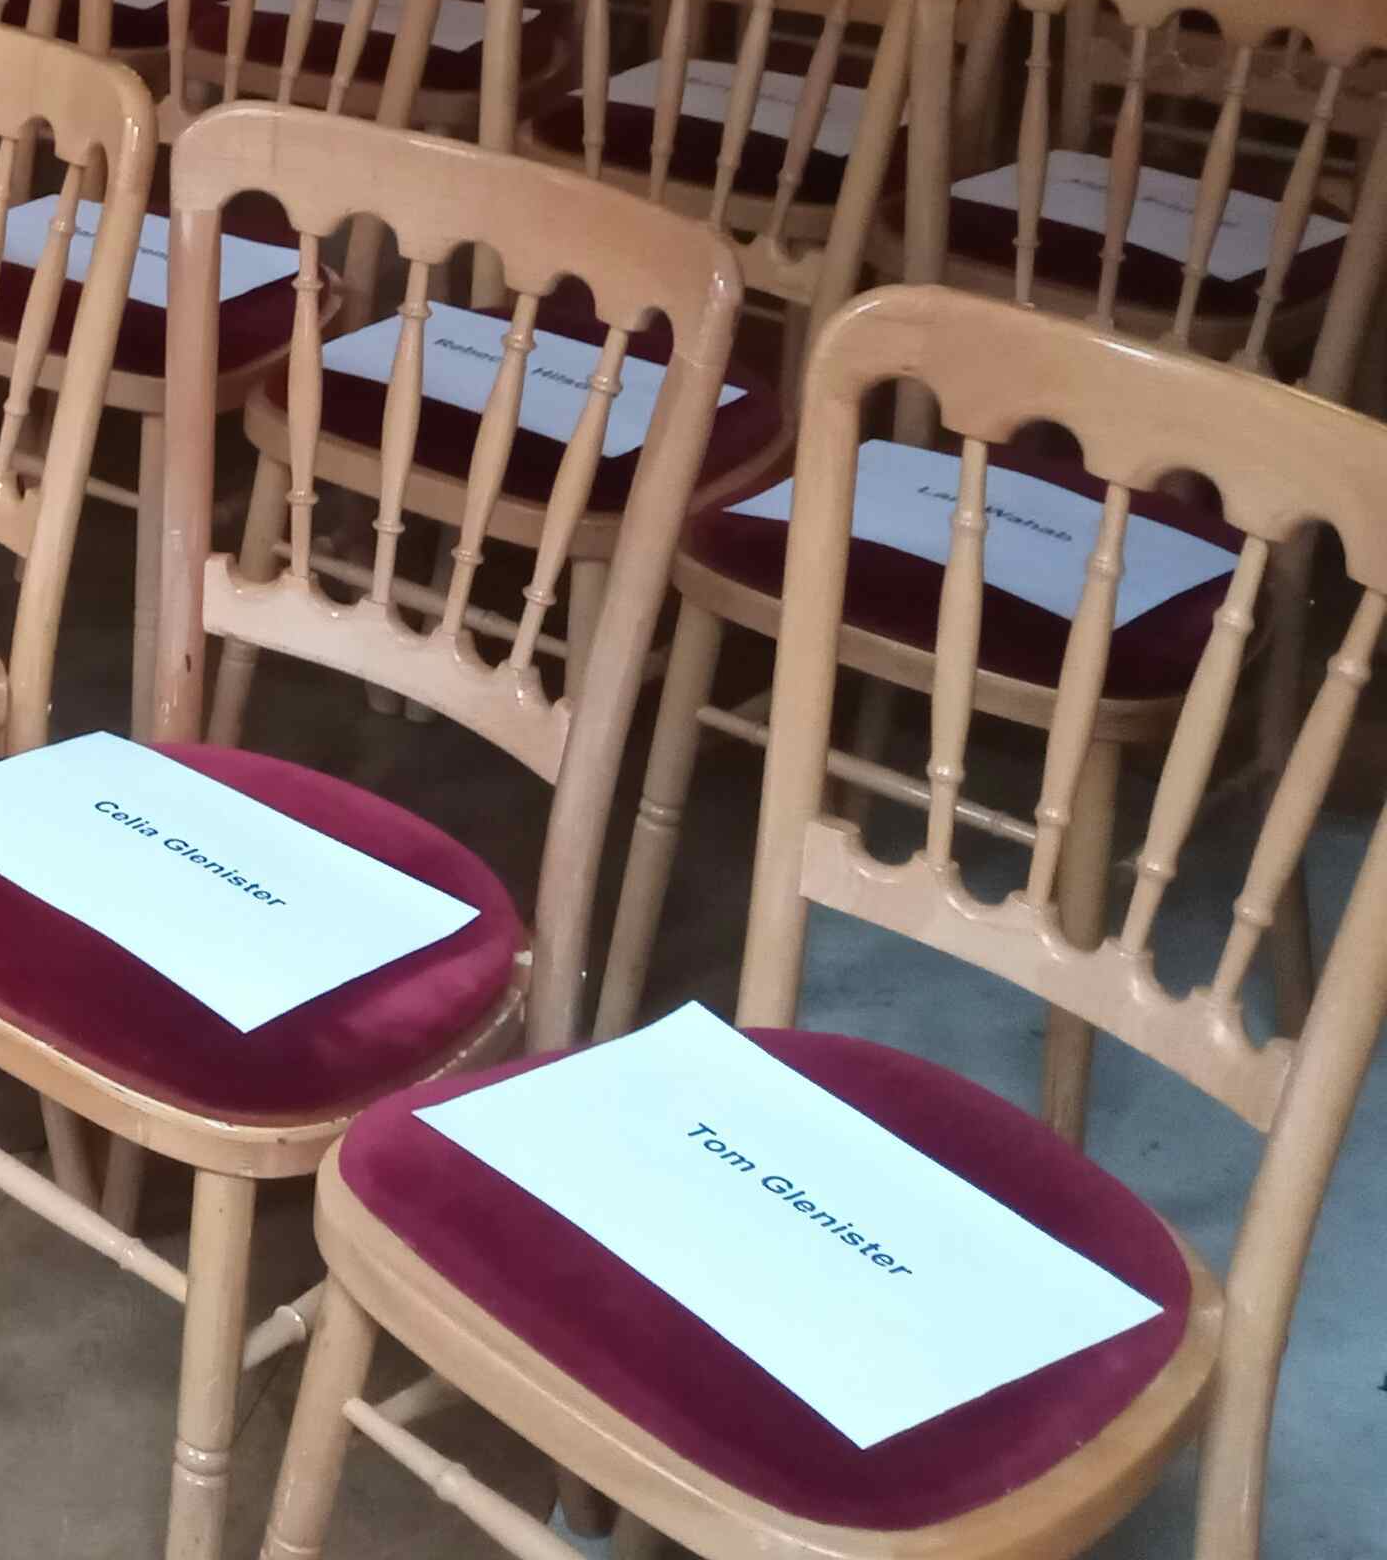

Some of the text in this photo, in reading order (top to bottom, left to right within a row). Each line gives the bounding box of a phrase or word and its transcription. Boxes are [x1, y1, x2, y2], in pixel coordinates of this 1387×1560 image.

[93, 800, 287, 907] Celia Glenister
[687, 1122, 914, 1277] Tom Glenister
